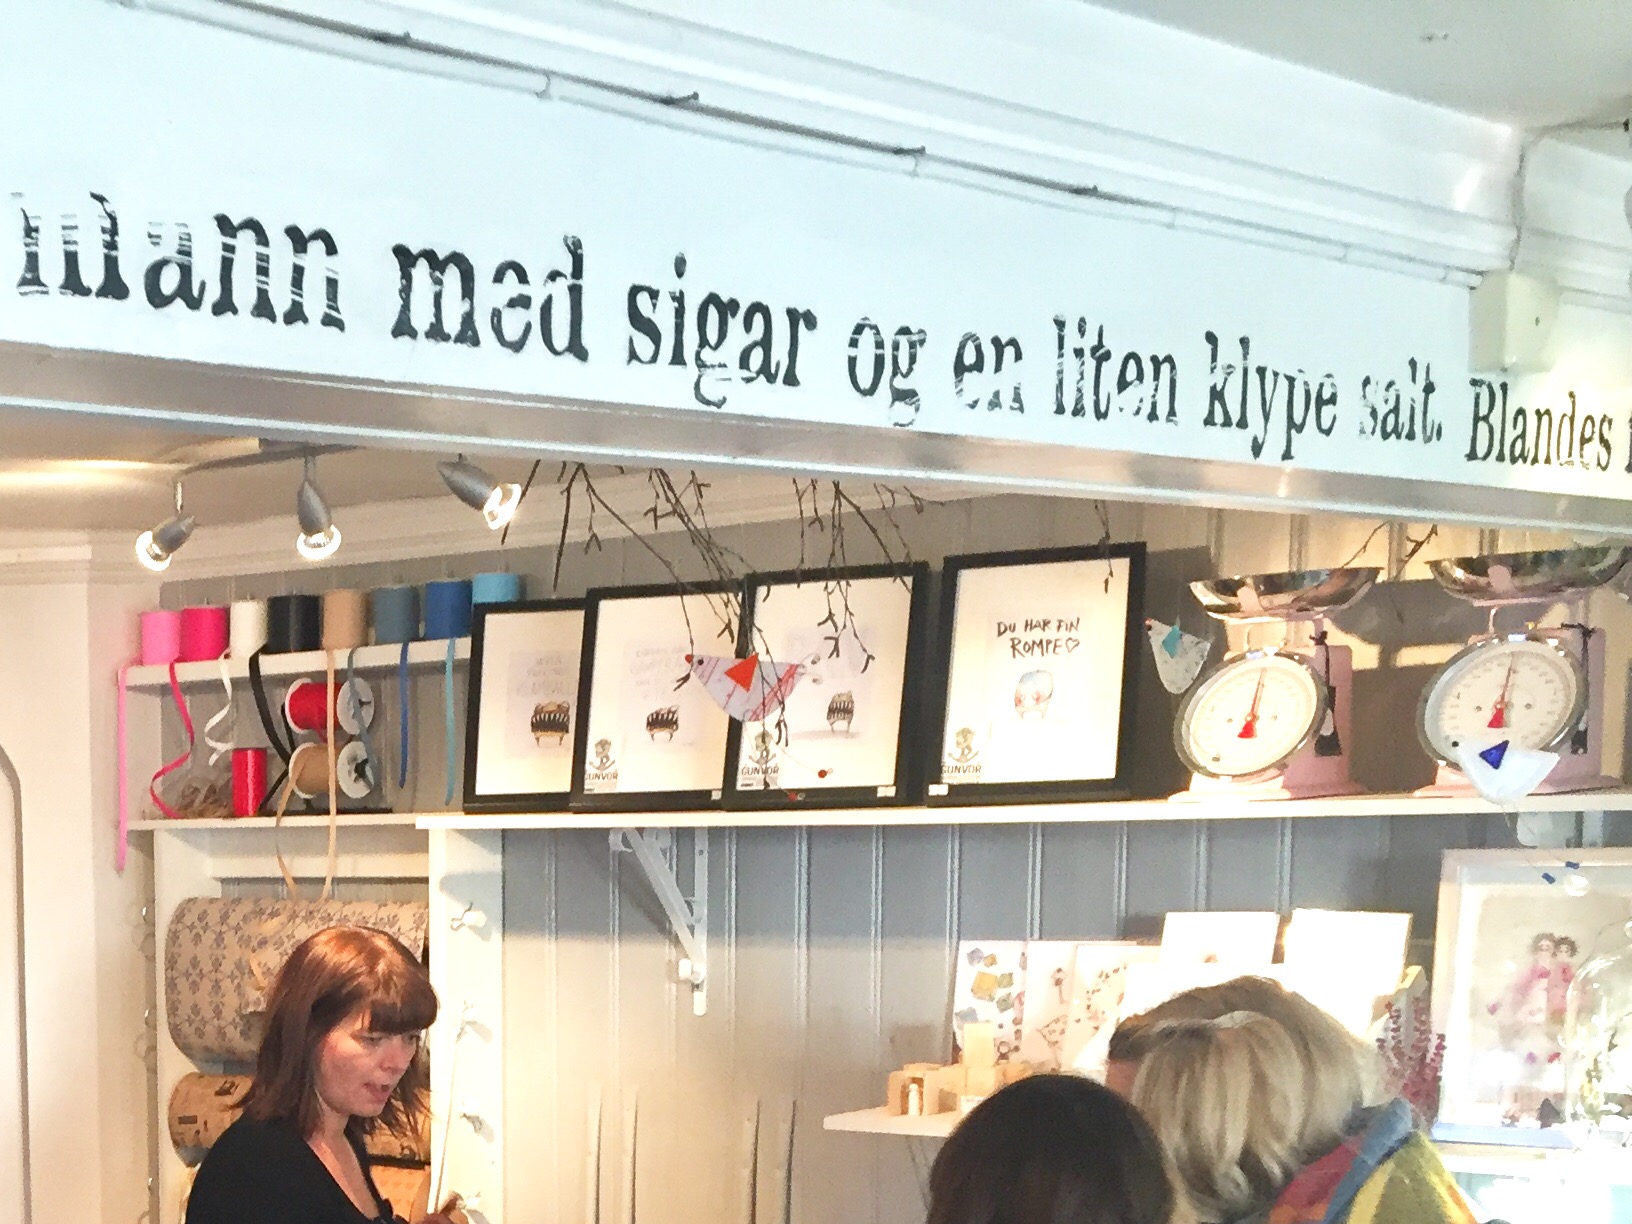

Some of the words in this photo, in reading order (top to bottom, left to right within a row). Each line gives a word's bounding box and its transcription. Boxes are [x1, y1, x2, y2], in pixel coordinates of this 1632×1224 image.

[390, 234, 590, 363] med
[625, 252, 819, 410] sigar
[846, 317, 928, 428] og
[953, 331, 1025, 416] en
[1052, 314, 1179, 425] liten
[1202, 330, 1340, 462] klype
[1358, 355, 1443, 445] salt.
[1464, 377, 1613, 472] Blandes
[996, 621, 1017, 637] DU
[1024, 618, 1051, 632] HAR
[1010, 636, 1064, 659] ROMPE
